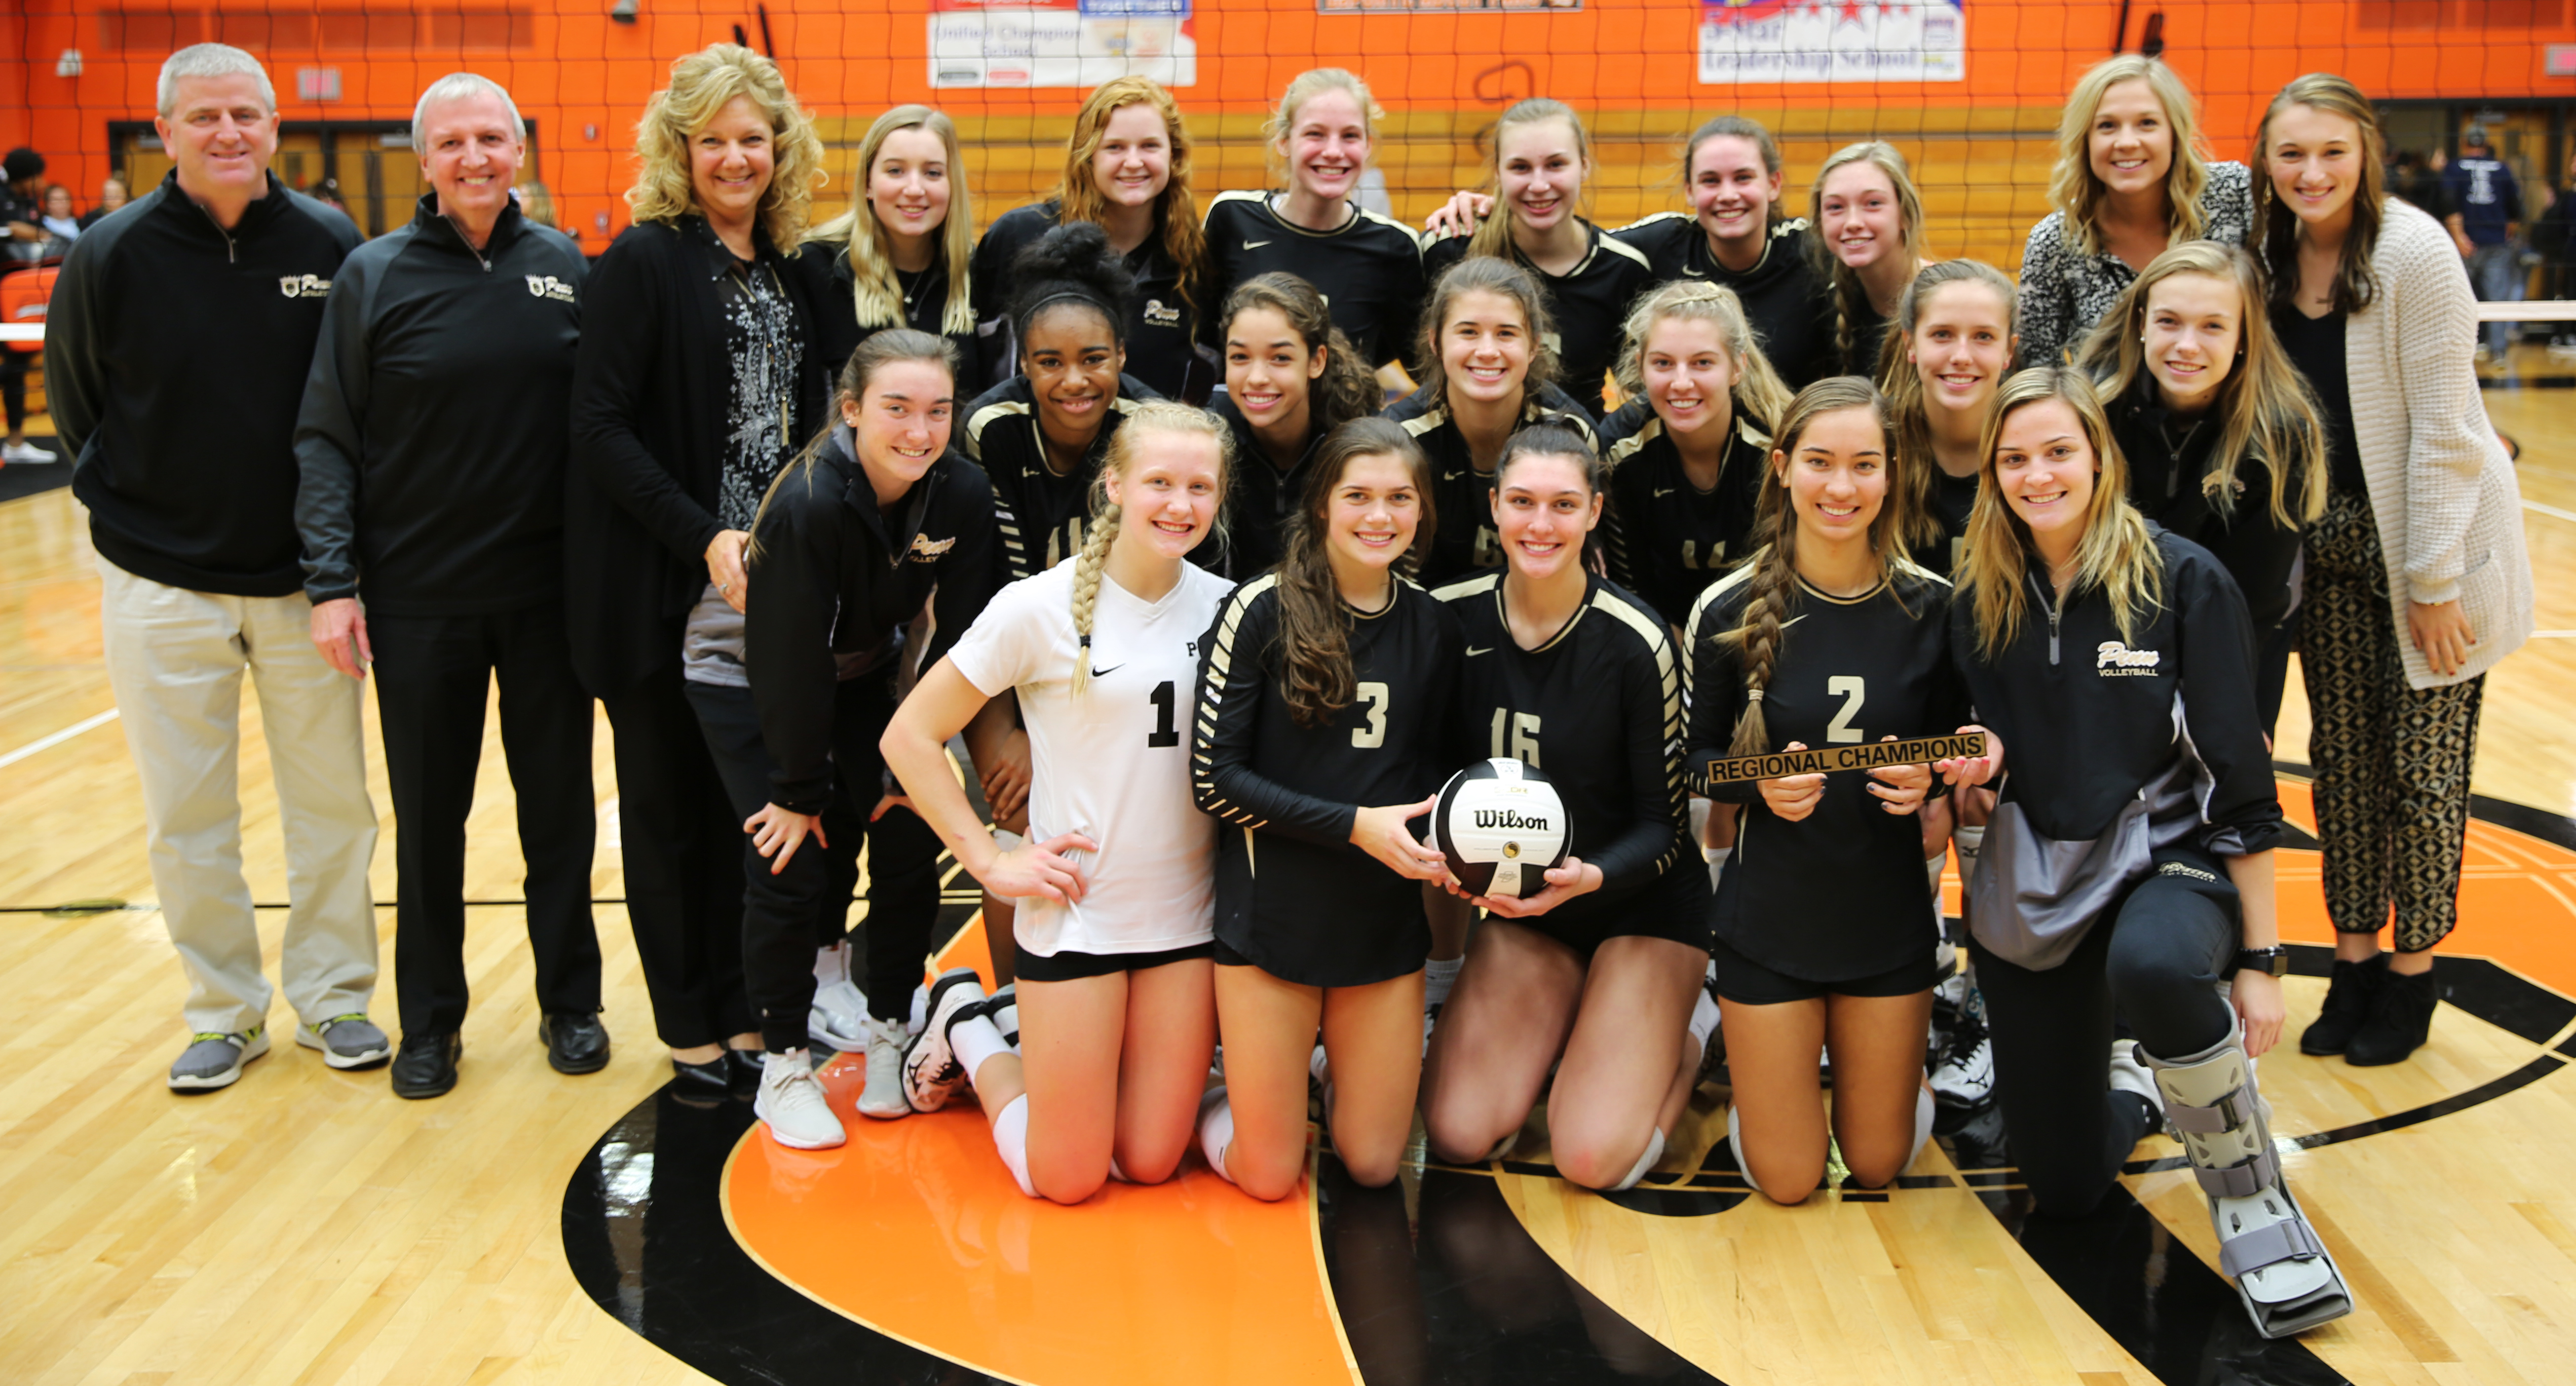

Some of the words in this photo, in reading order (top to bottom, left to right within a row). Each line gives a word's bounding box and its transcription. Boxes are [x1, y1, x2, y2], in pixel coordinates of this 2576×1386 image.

[936, 26, 992, 40] Unified
[1002, 26, 1082, 43] Champion
[1705, 48, 1829, 75] Leadership
[1841, 48, 1917, 70] School
[908, 533, 956, 555] Penn
[2097, 641, 2160, 668] Penn
[2098, 668, 2159, 677] VOLLEYBALL
[1148, 681, 1179, 747] 1
[1352, 682, 1389, 748] 3
[1827, 676, 1864, 743] 2
[1491, 707, 1541, 769] 16
[1712, 752, 1832, 781] REGIONAL
[1838, 736, 1981, 767] CHAMPIONS
[1474, 809, 1549, 831] Wilson
